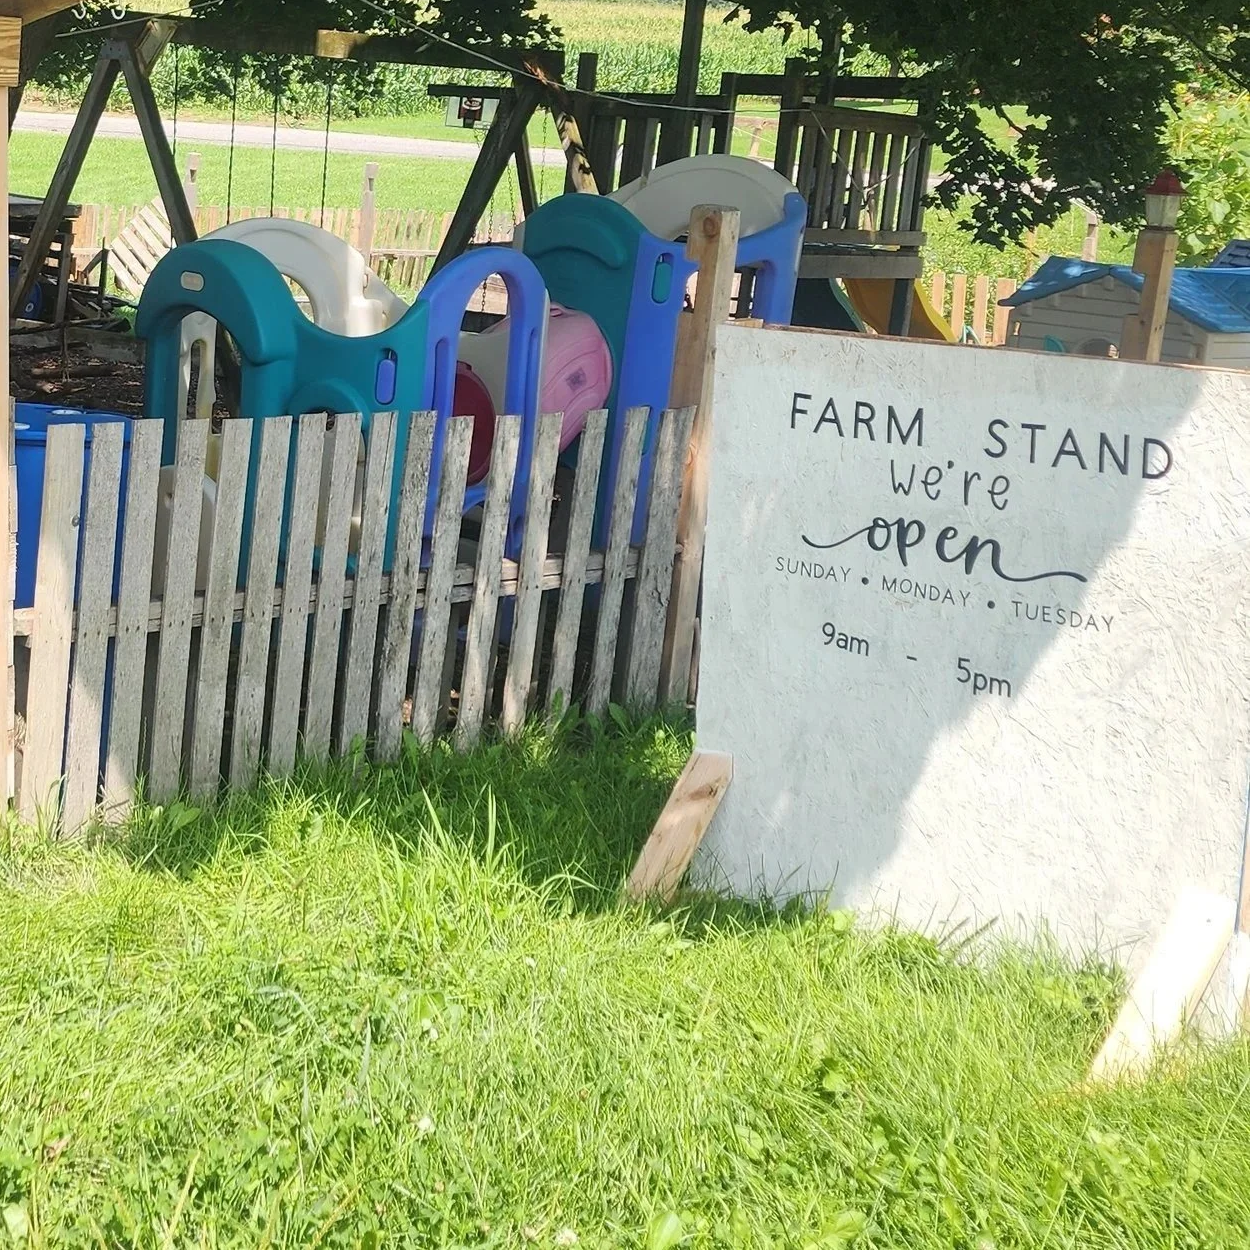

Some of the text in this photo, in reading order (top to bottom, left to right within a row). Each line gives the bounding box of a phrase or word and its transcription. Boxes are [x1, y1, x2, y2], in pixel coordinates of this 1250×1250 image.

[790, 392, 1173, 480] FARM STAND
[775, 556, 1114, 633] SUNDAY MONDAY TUESDAY
[821, 621, 870, 657] 9am
[956, 656, 1012, 698] 5pm
